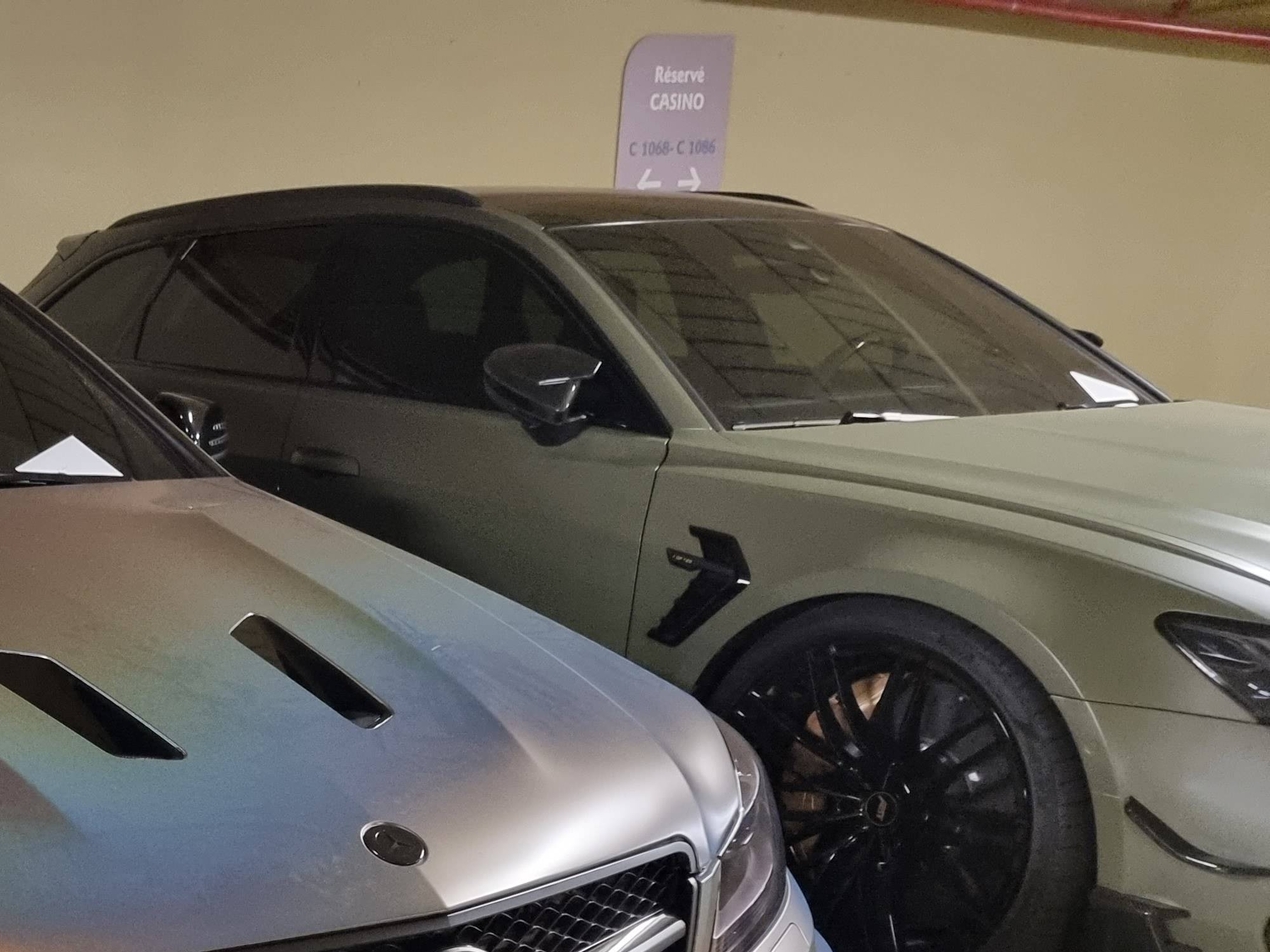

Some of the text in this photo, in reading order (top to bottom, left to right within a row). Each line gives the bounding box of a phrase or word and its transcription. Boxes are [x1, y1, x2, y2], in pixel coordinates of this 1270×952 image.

[654, 66, 705, 84] Réservé
[650, 93, 705, 111] CASINO
[629, 141, 637, 156] C
[676, 139, 685, 155] C
[689, 138, 716, 155] 1086
